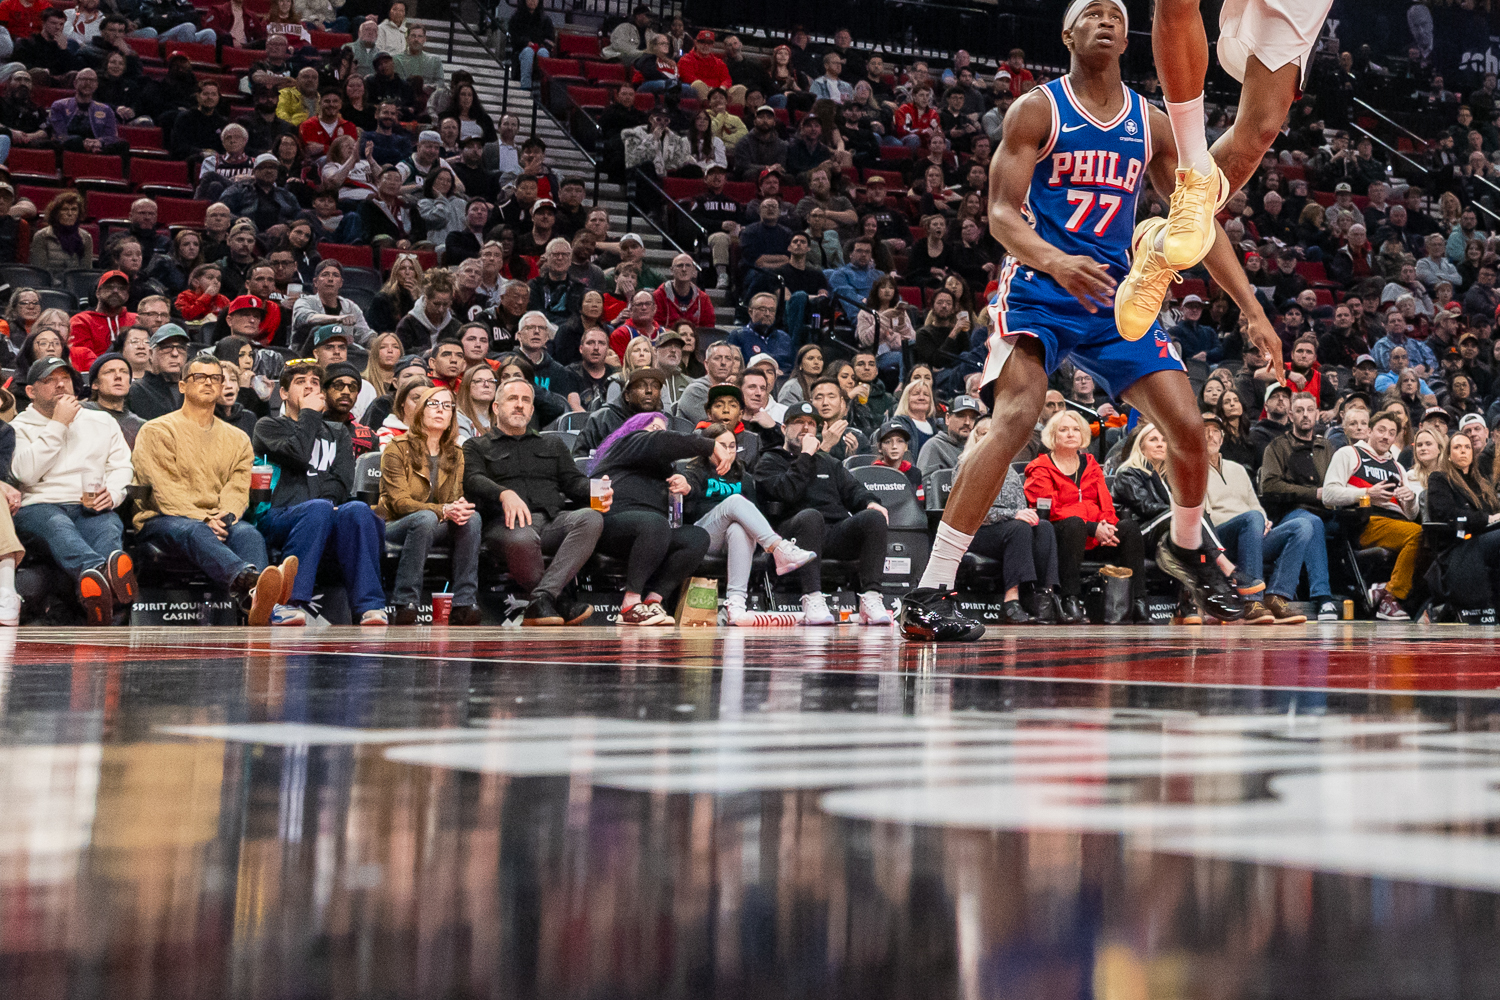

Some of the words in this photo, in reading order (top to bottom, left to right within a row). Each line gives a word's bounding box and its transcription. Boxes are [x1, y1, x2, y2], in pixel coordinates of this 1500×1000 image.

[1049, 150, 1142, 194] PHILA
[1065, 189, 1122, 237] 77
[132, 602, 168, 612] SPIRIT
[960, 602, 986, 611] SPIRIT
[162, 612, 205, 621] CASINO
